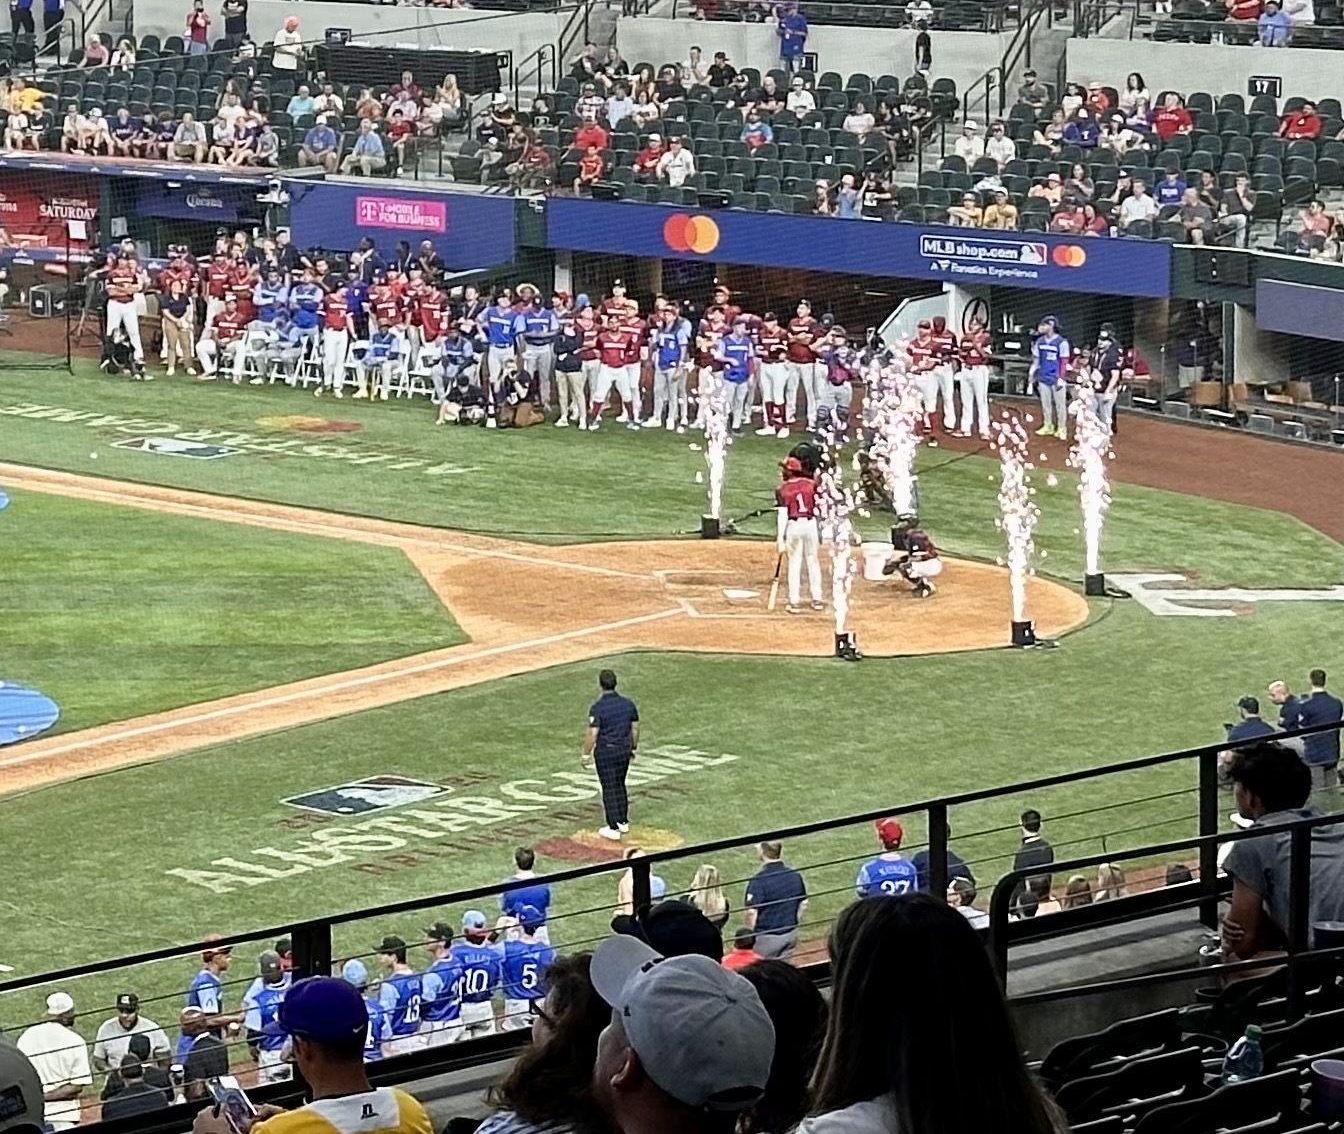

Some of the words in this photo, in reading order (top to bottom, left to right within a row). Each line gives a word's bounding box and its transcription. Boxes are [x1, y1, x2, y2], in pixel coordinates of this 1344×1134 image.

[1255, 80, 1269, 94] 17
[39, 204, 97, 220] SATURDAY
[796, 493, 808, 513] 1
[464, 967, 489, 994] 10
[521, 963, 538, 989] 5
[402, 994, 421, 1023] 13
